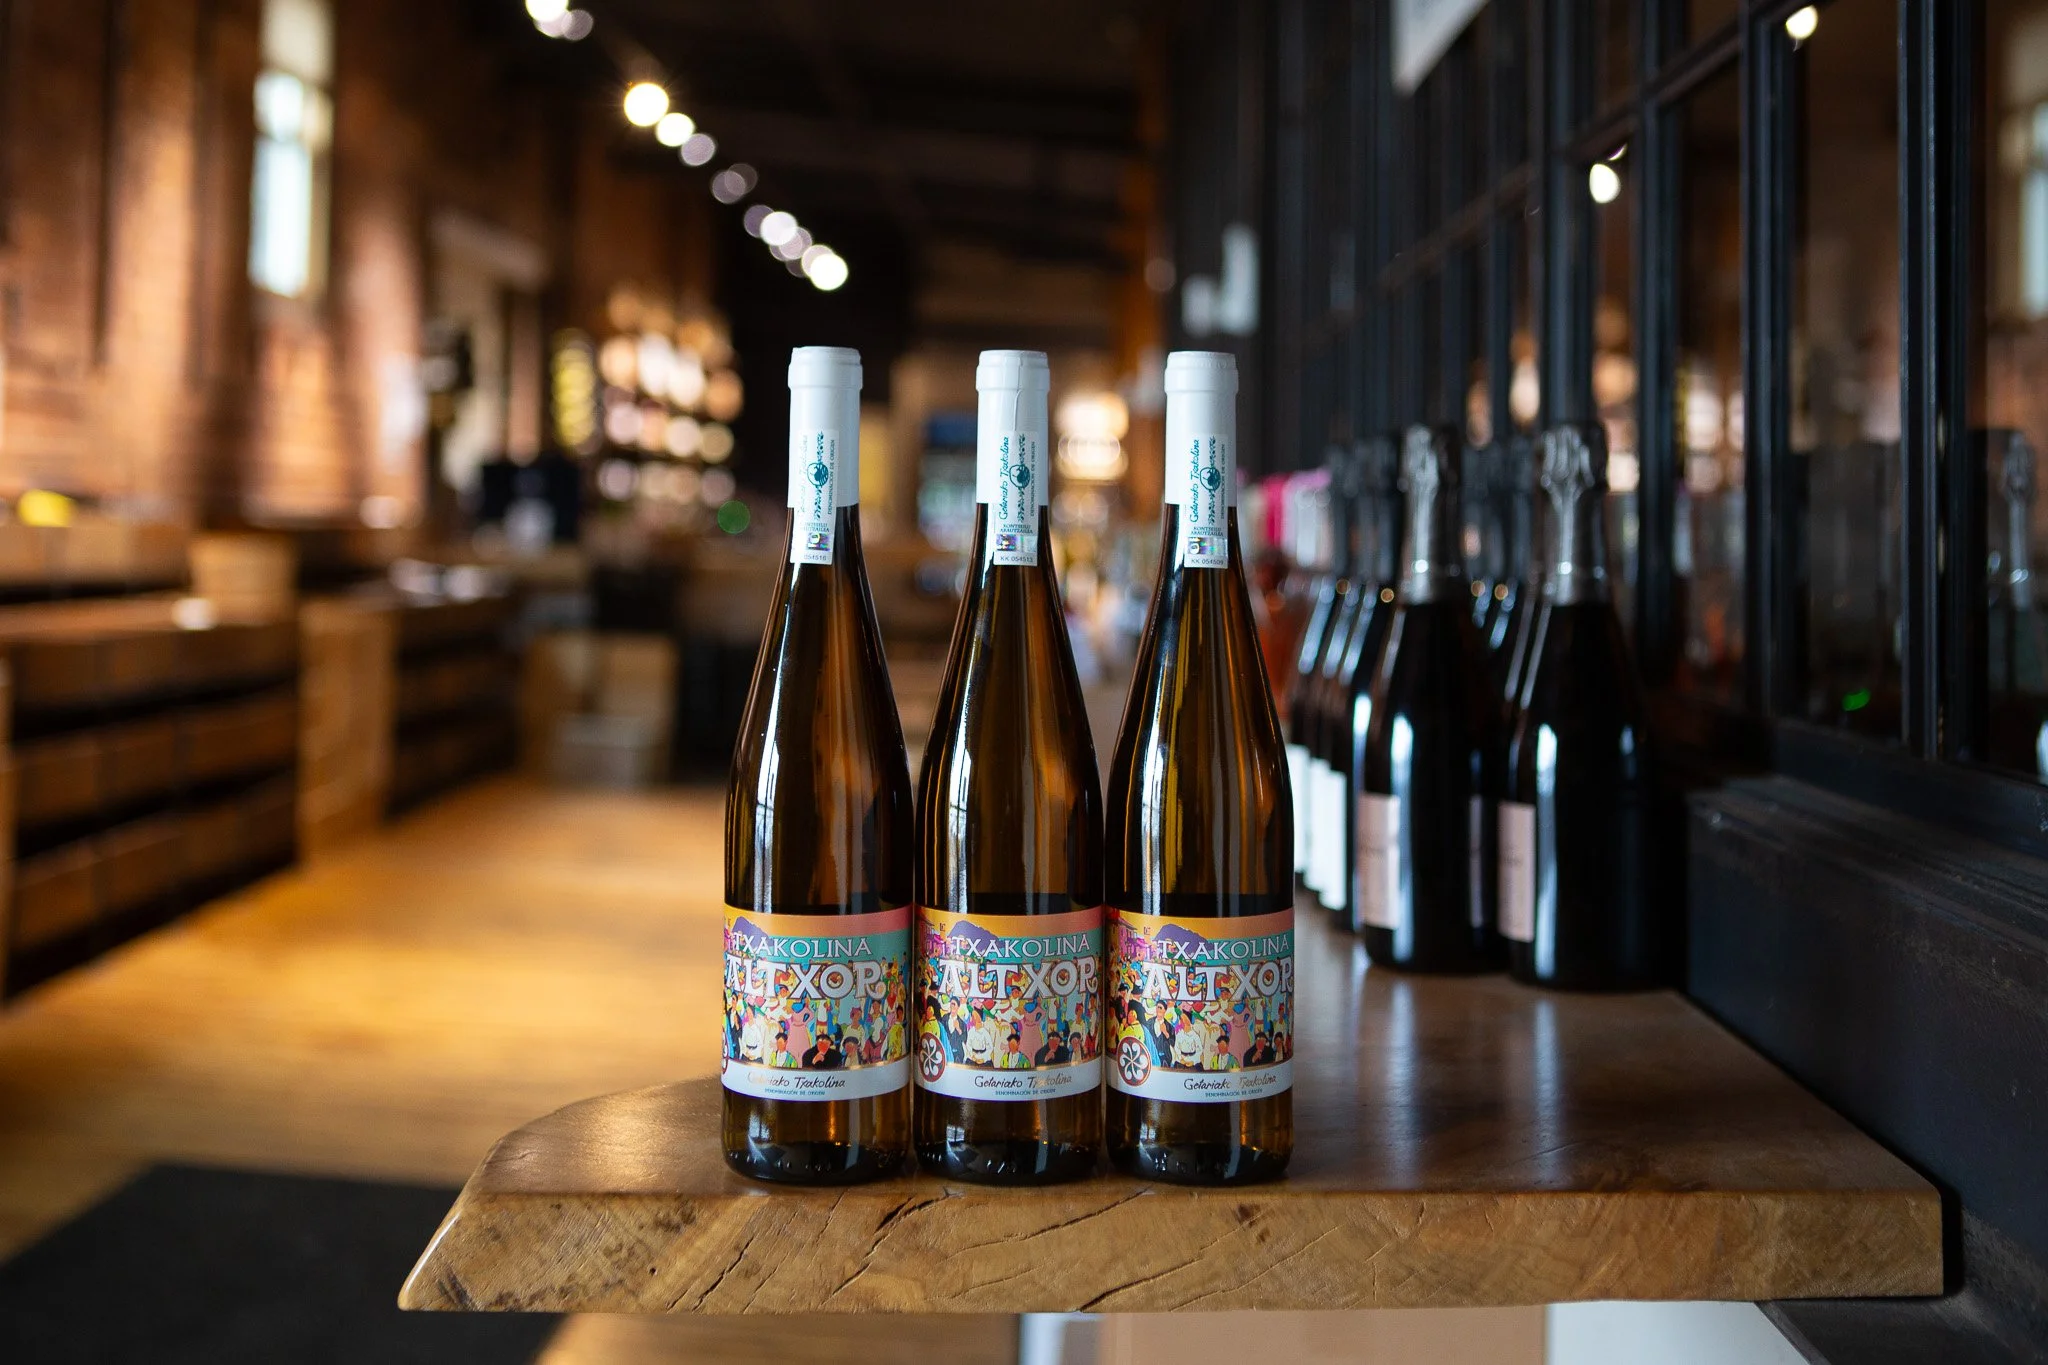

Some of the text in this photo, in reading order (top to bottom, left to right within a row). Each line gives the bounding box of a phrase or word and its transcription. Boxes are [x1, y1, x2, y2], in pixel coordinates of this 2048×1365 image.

[733, 931, 872, 958] TXAKOLINA
[950, 933, 1091, 958] TXAKOLINA
[1157, 934, 1290, 960] TXAKOLINA
[725, 954, 887, 1001] ALTXOR
[938, 955, 1098, 1000] ALTXOR
[1140, 956, 1294, 1002] ALTXOR
[794, 1075, 846, 1090] Txakolina
[974, 1075, 1023, 1089] Getariako
[1183, 1073, 1277, 1091] Getariako Txakolina
